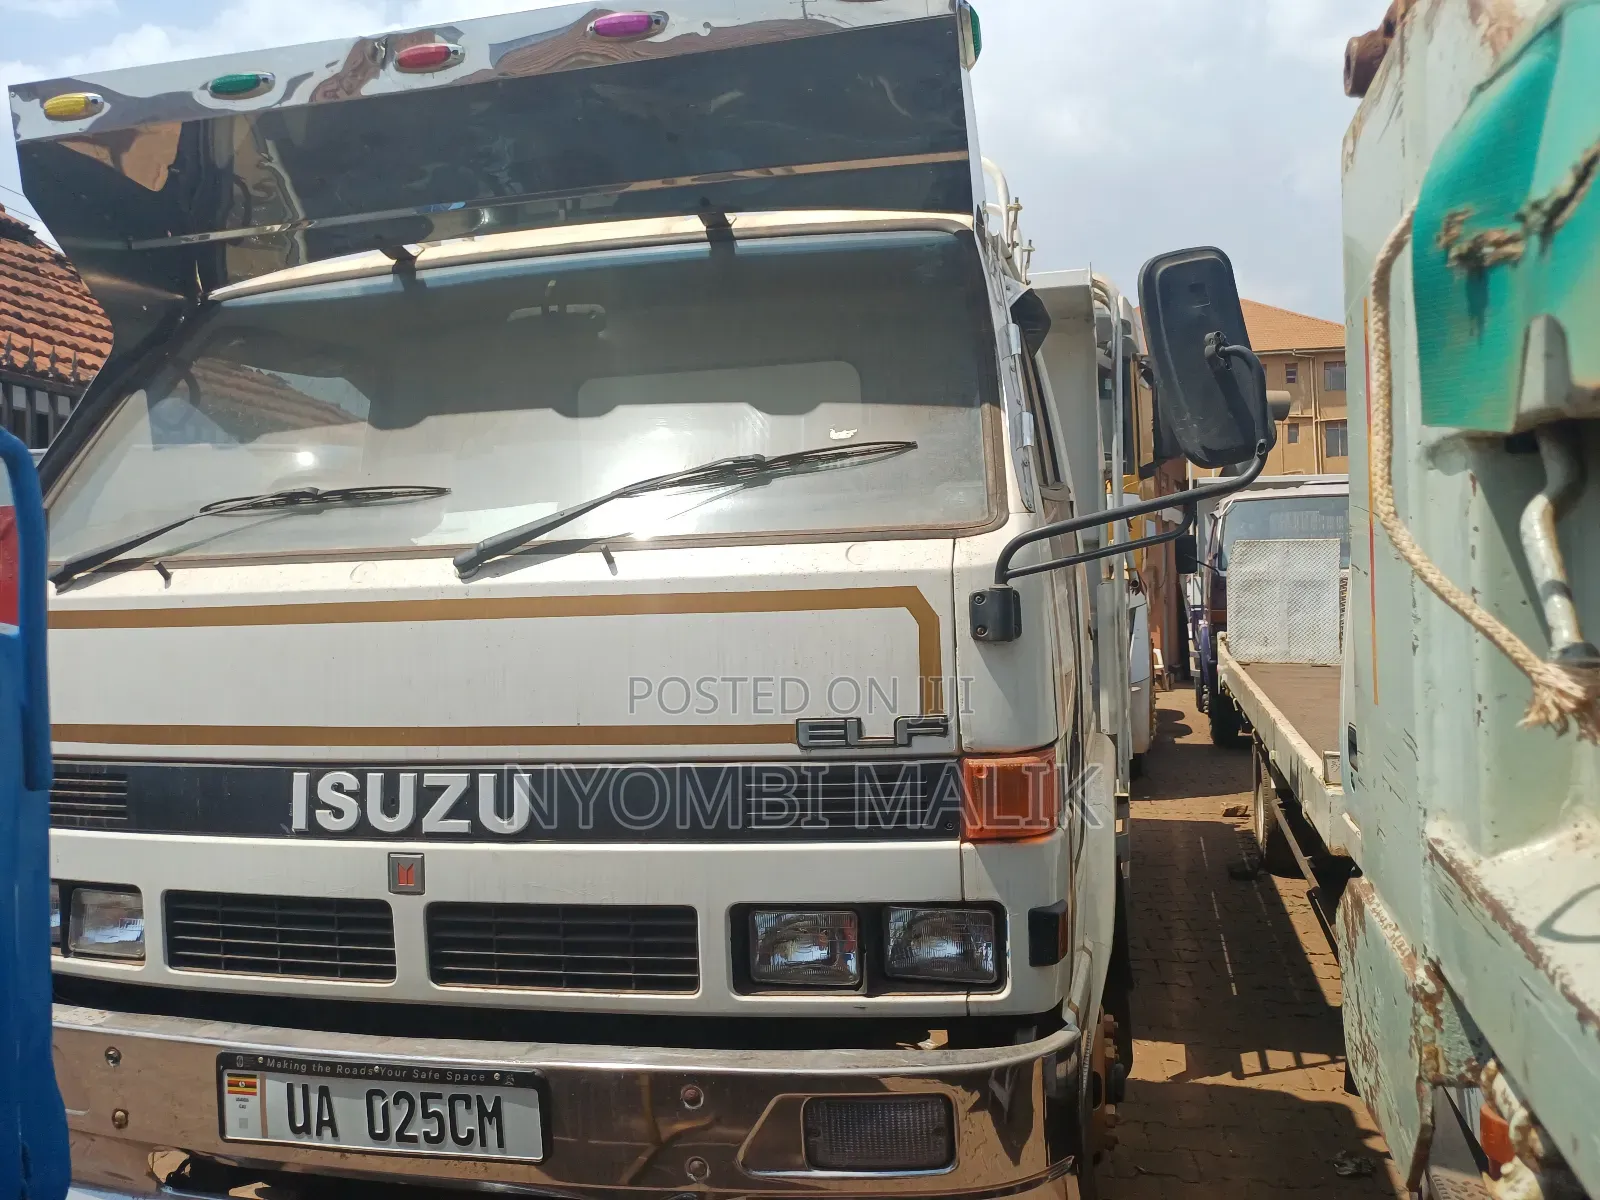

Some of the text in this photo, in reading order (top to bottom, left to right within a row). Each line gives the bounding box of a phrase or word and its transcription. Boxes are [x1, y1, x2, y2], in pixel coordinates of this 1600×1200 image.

[796, 714, 949, 750] ELF
[292, 771, 533, 834] ISUZU
[266, 1057, 307, 1073] Making
[312, 1062, 331, 1074] the
[336, 1064, 373, 1077] Roads
[380, 1066, 407, 1079] Your
[412, 1069, 440, 1080] Safe
[446, 1071, 486, 1083] Space
[286, 1082, 505, 1149] UA 025CM
